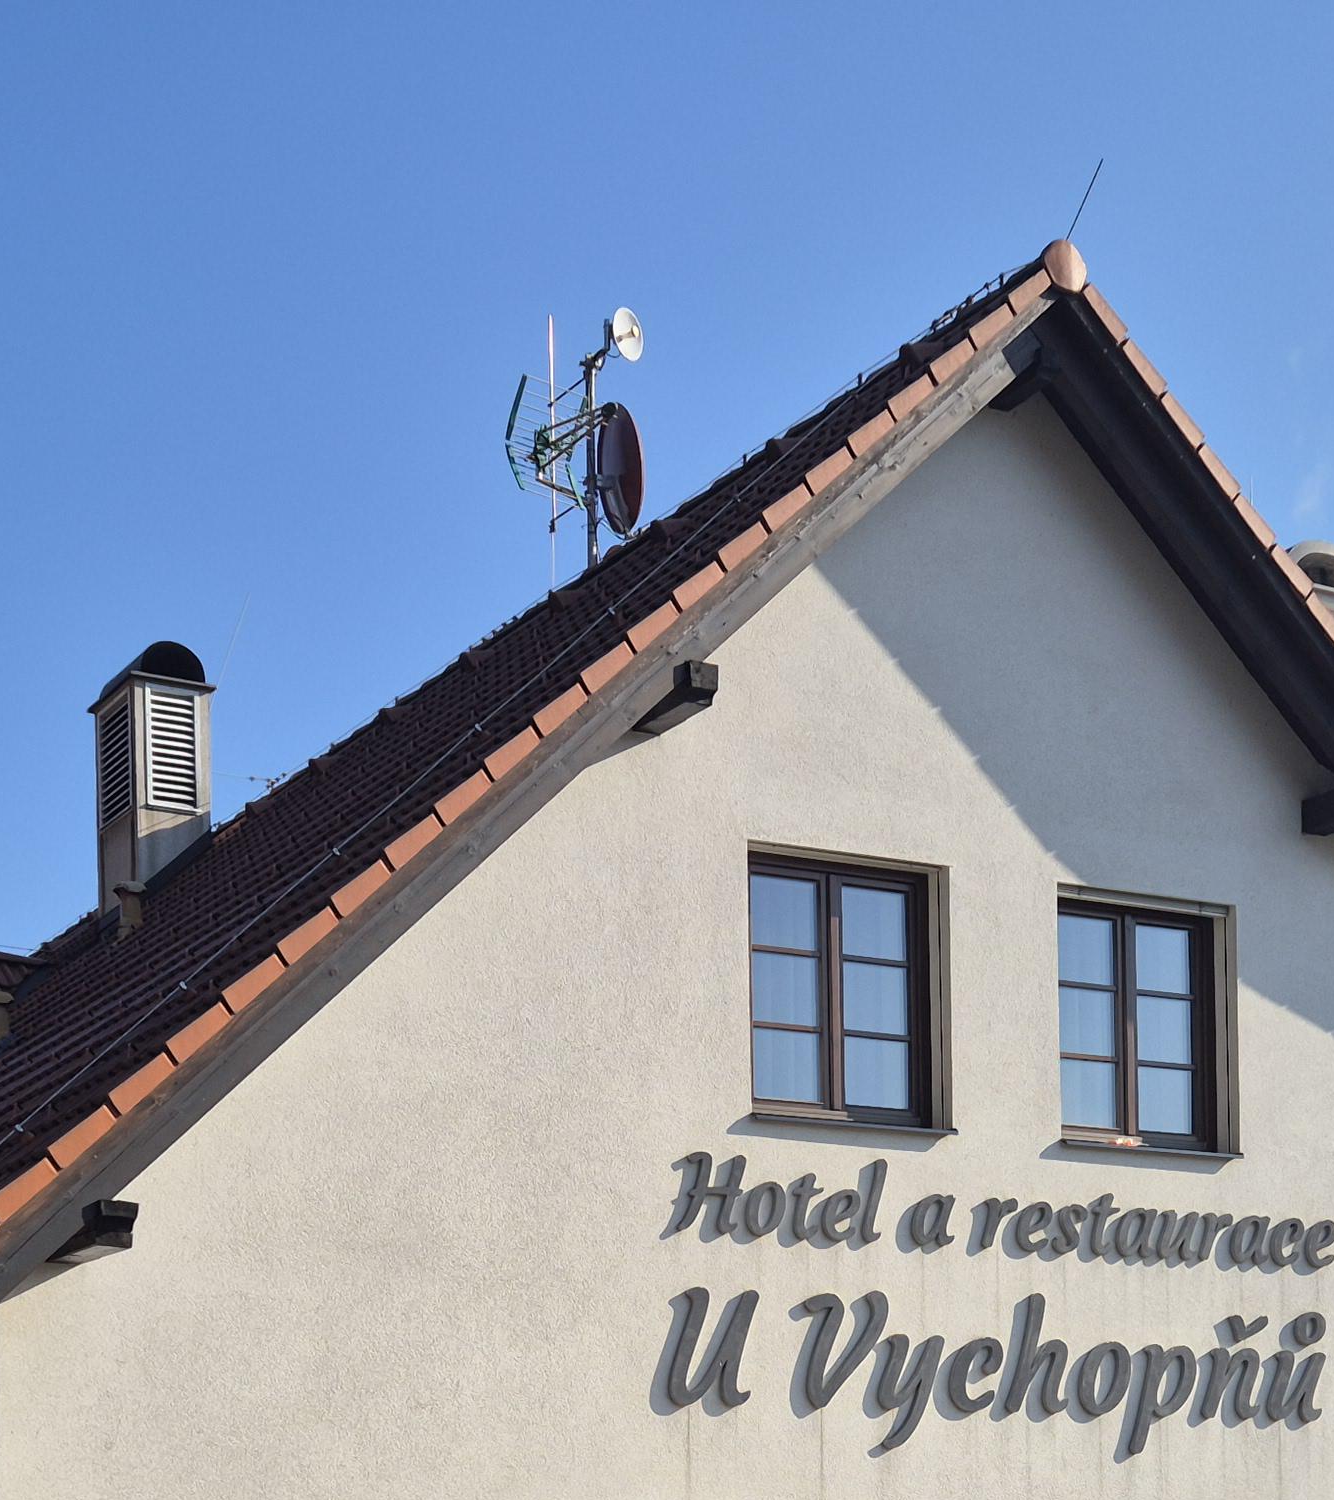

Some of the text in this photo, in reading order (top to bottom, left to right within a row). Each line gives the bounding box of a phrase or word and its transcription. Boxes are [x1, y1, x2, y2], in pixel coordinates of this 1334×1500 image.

[671, 1150, 888, 1243] Hotel
[909, 1192, 957, 1248] a
[667, 1287, 1327, 1456] U Vychopňů
